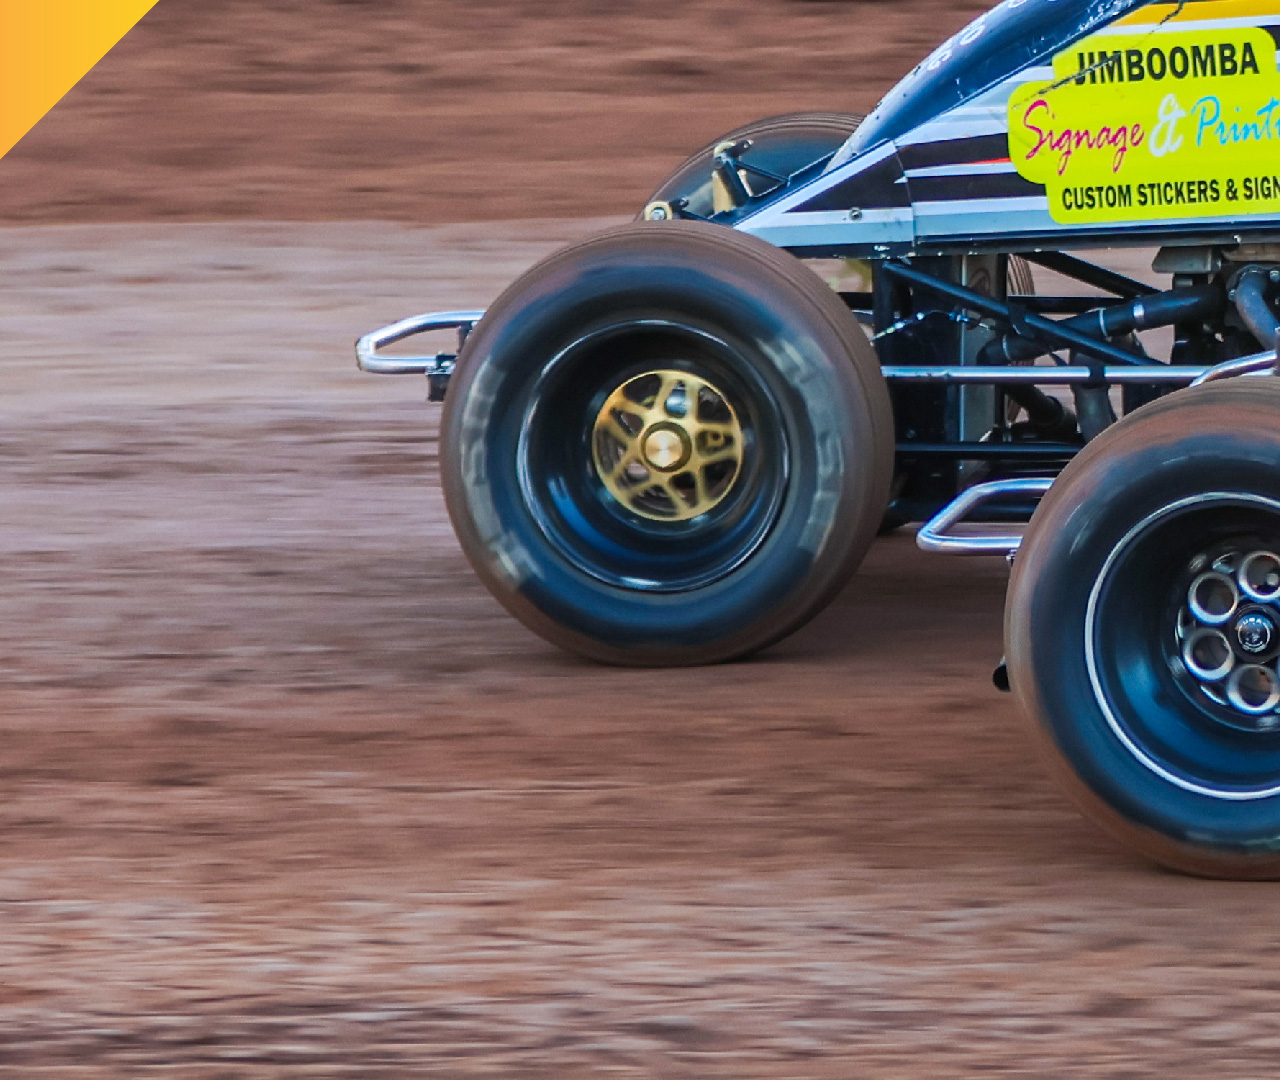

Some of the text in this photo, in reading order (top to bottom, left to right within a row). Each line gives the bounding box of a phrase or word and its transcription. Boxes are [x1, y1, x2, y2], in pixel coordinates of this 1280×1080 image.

[1074, 42, 1260, 86] JIMBOOMBA
[1023, 99, 1145, 176] Signage
[1148, 93, 1187, 158] &
[1062, 184, 1132, 211] CUSTOM
[1138, 179, 1220, 206] STICKERS
[1226, 179, 1238, 199] &
